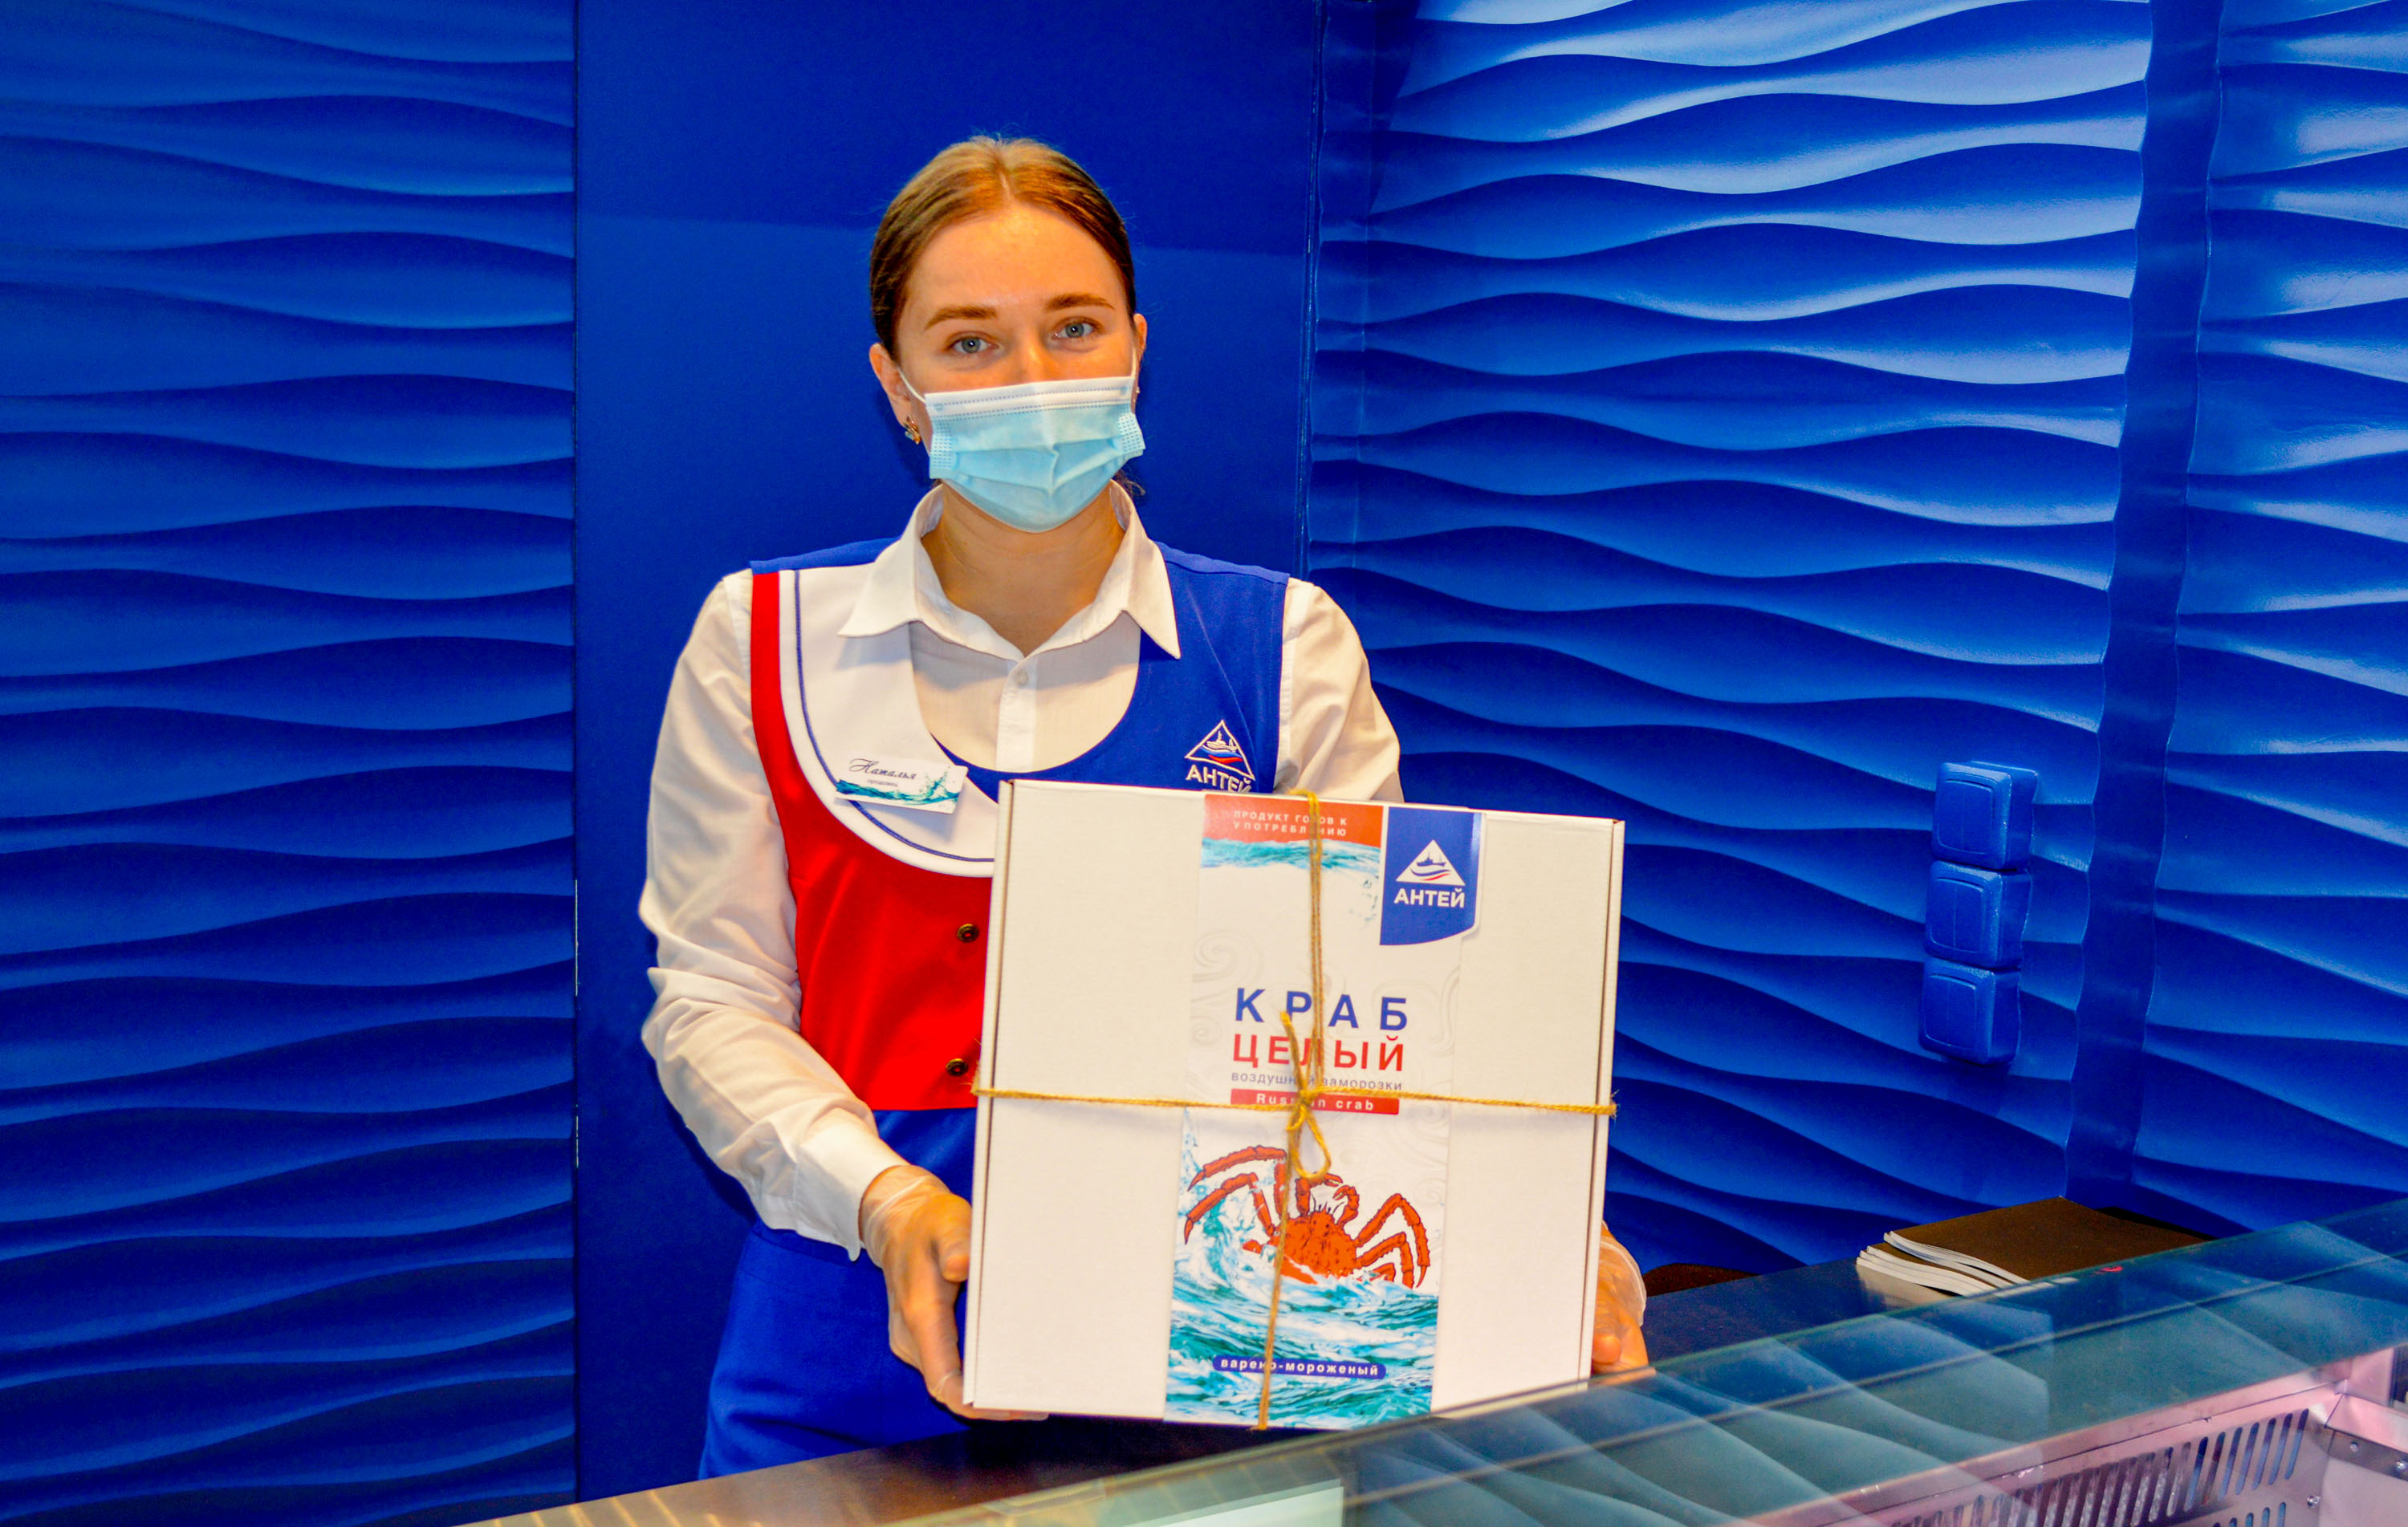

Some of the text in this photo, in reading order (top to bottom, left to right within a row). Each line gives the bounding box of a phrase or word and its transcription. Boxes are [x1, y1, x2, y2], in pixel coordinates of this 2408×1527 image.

[849, 758, 917, 780] Наталья
[1186, 764, 1252, 792] АНТЕЙ
[1234, 810, 1348, 826] ПРОДУКТ ГООВ К
[1234, 822, 1347, 836] УПОТРЕБЛНИЮ
[1393, 887, 1465, 908] АНТЕЙ
[1235, 988, 1408, 1031] КРАБ
[1231, 1072, 1402, 1090] воздушнй заморозки
[1256, 1093, 1374, 1111] Russn crab
